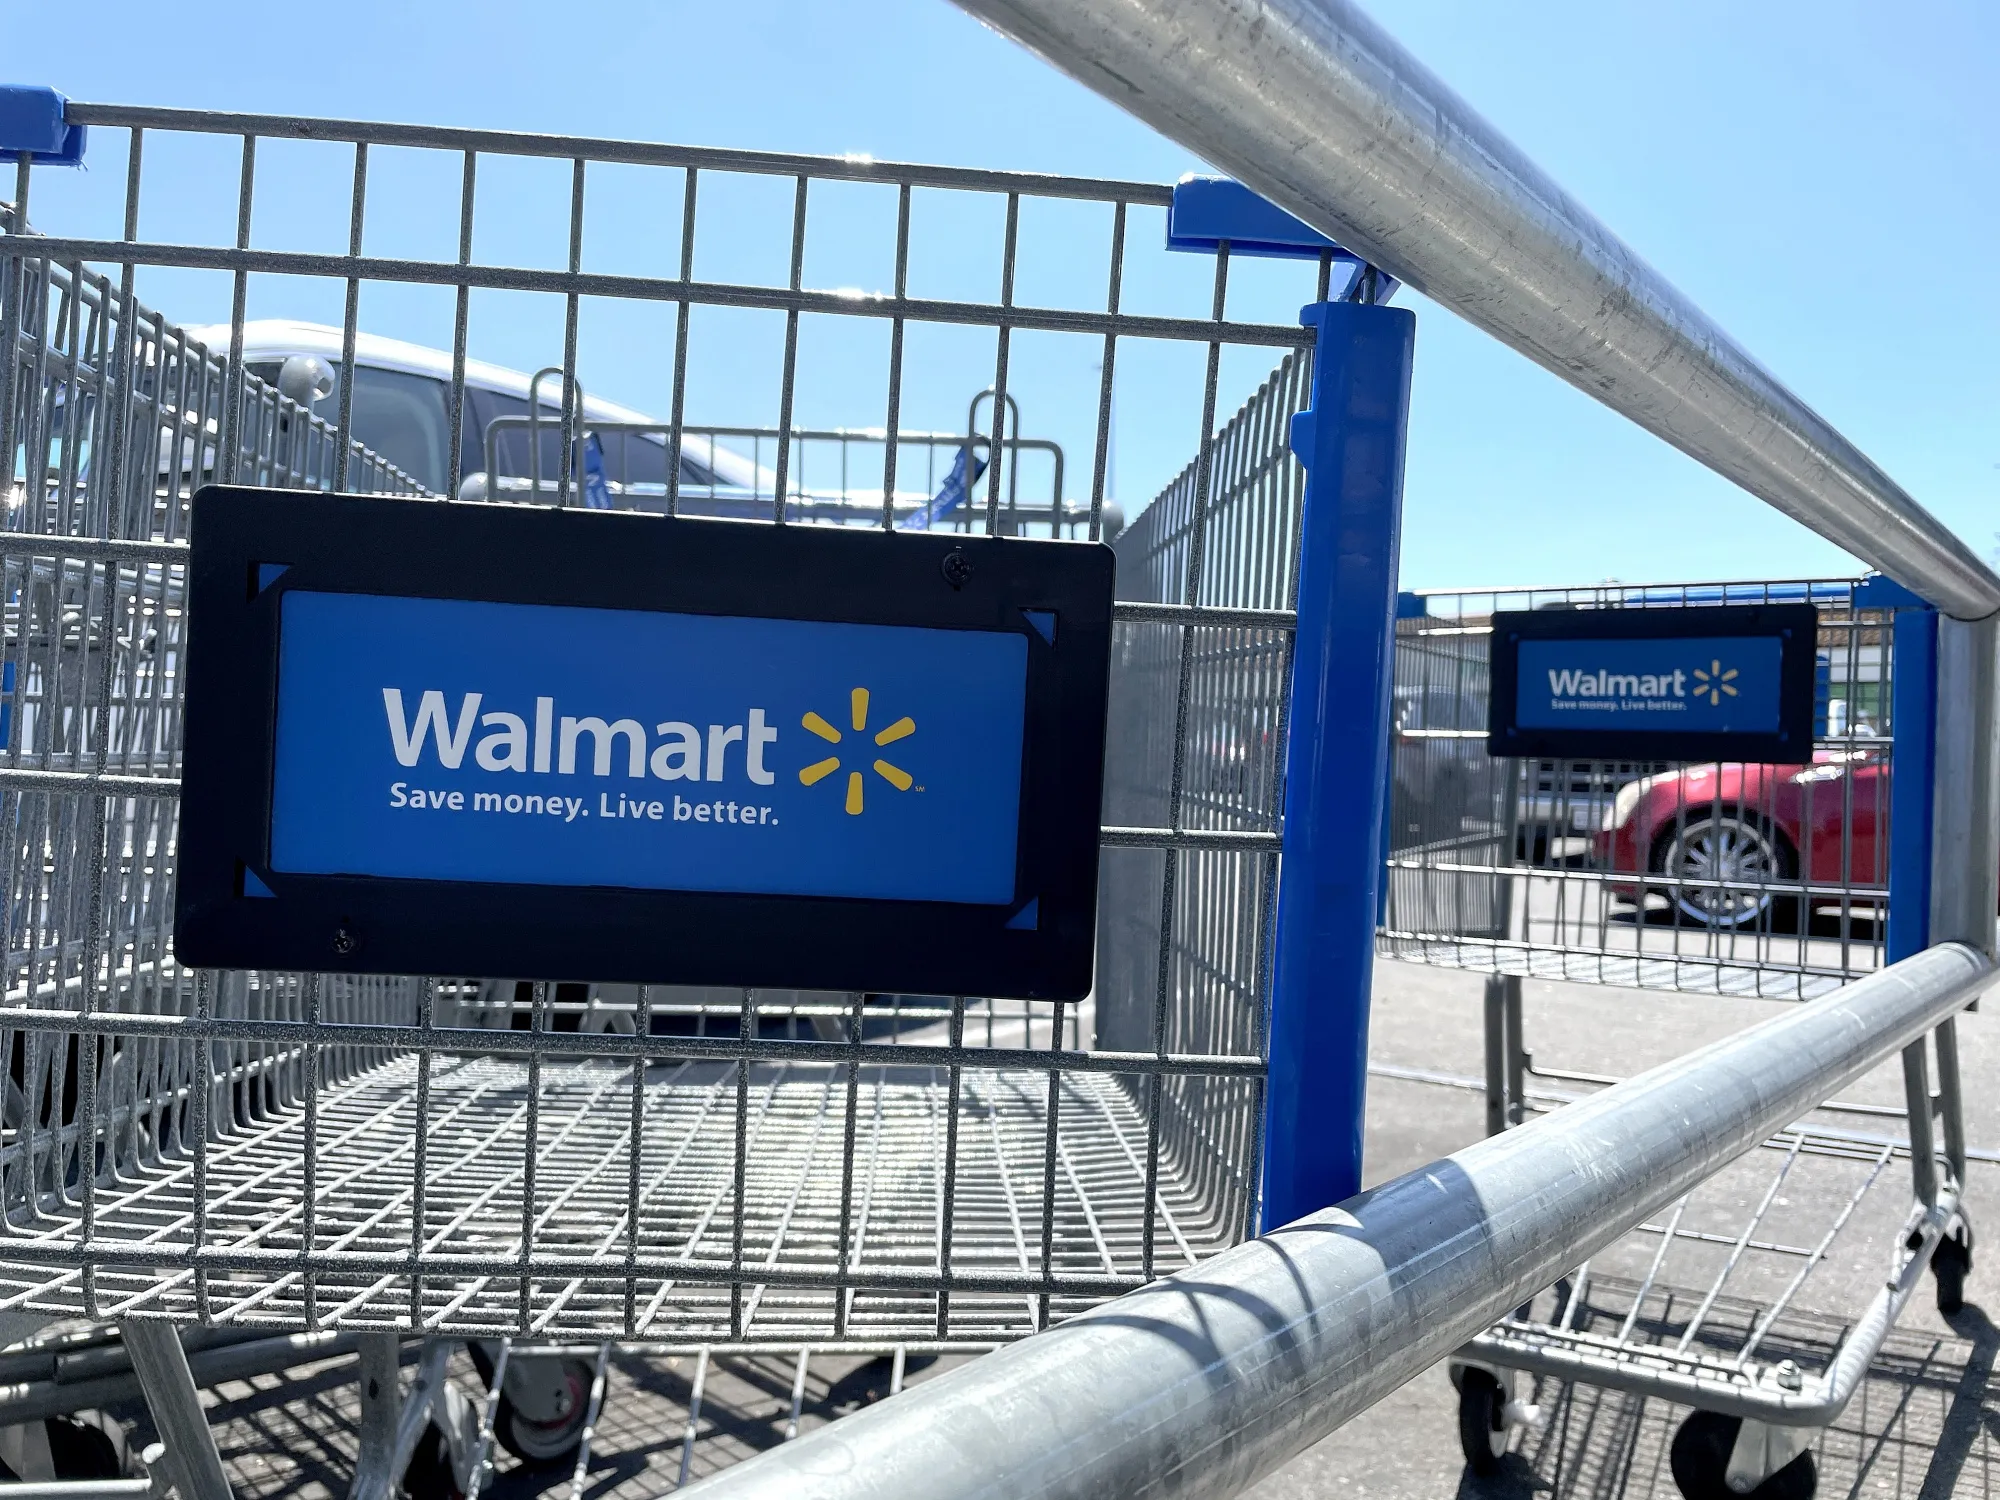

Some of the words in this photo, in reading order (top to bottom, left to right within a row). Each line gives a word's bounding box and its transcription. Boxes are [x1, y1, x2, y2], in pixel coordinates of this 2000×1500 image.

[1548, 668, 1687, 697] Walmart
[1551, 699, 1577, 710] Save
[1621, 699, 1645, 711] Live
[382, 687, 778, 786] Walmart
[389, 782, 464, 811] Save
[473, 792, 589, 823] money.
[600, 792, 664, 820] Live
[673, 795, 779, 826] better.
